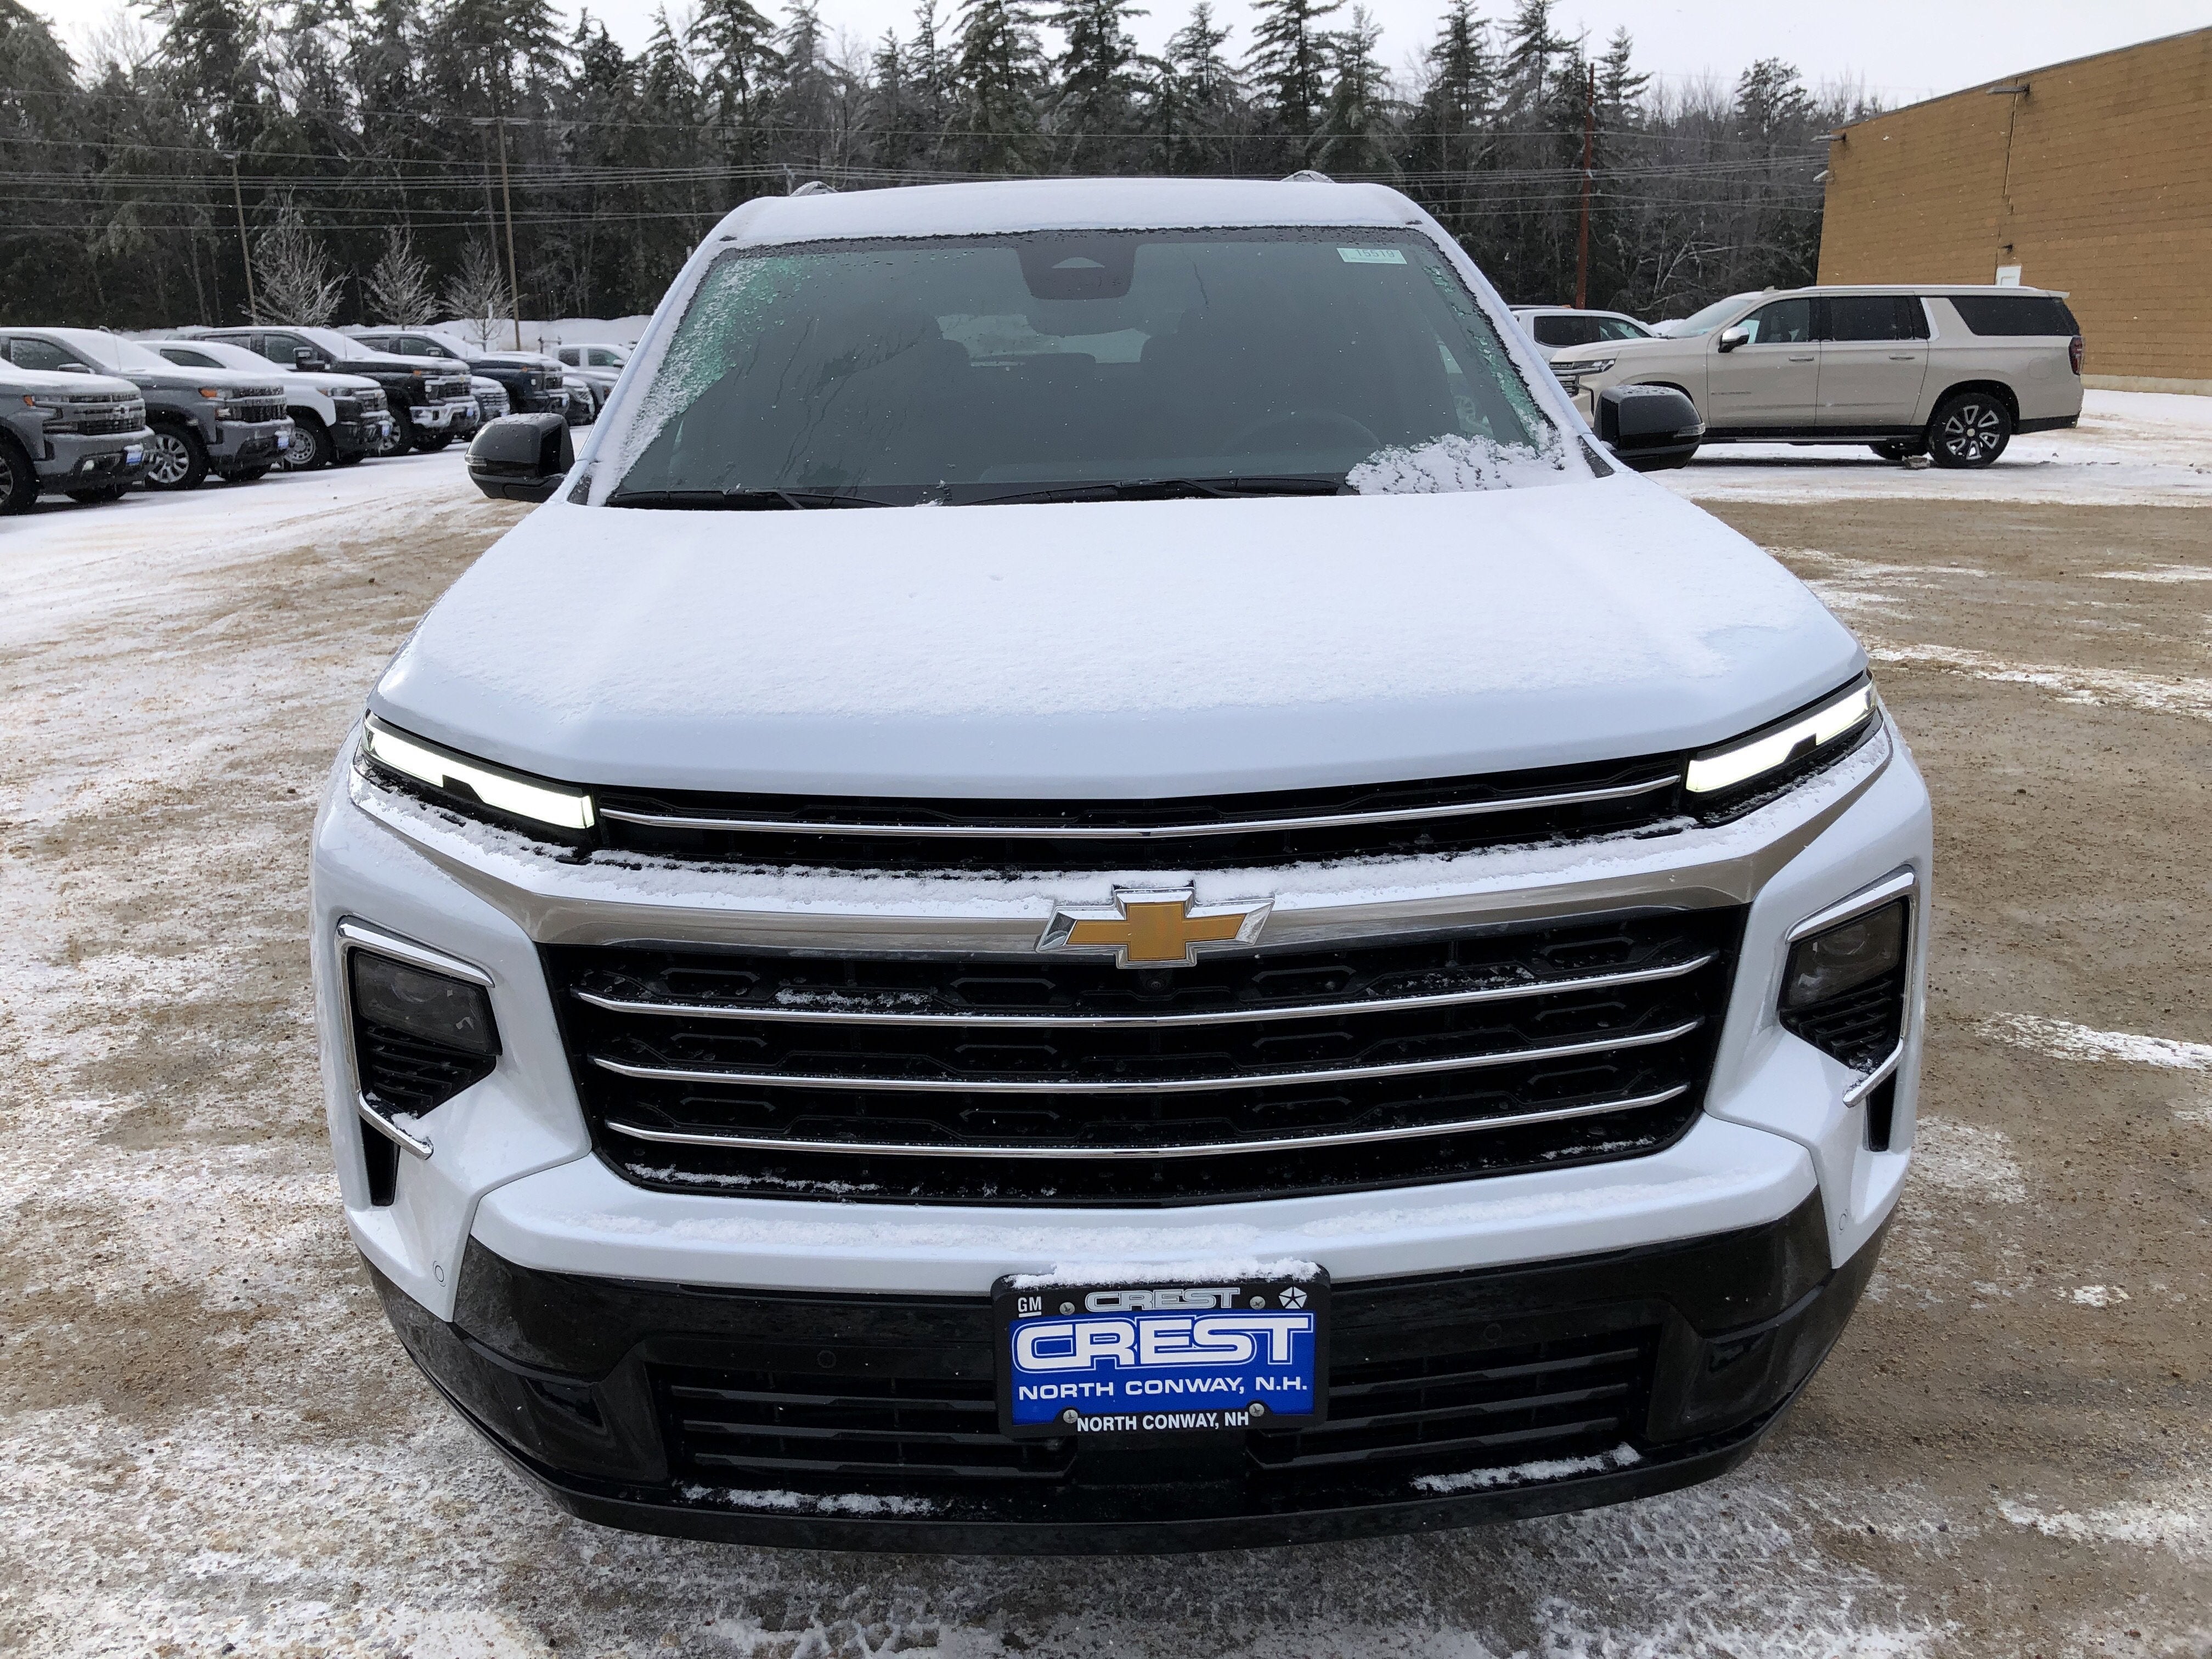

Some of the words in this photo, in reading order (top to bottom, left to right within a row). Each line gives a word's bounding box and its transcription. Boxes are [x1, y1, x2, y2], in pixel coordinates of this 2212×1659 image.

[1018, 1296, 1042, 1313] GM
[1086, 1288, 1240, 1312] CREST
[1012, 1313, 1313, 1373] CREST
[1019, 1381, 1114, 1400] NORTH
[1125, 1378, 1244, 1395] CONWAY,
[1255, 1377, 1307, 1391] N.H.
[1077, 1415, 1137, 1432] NORTH
[1142, 1413, 1219, 1430] CONWAY,
[1224, 1412, 1249, 1426] NH
